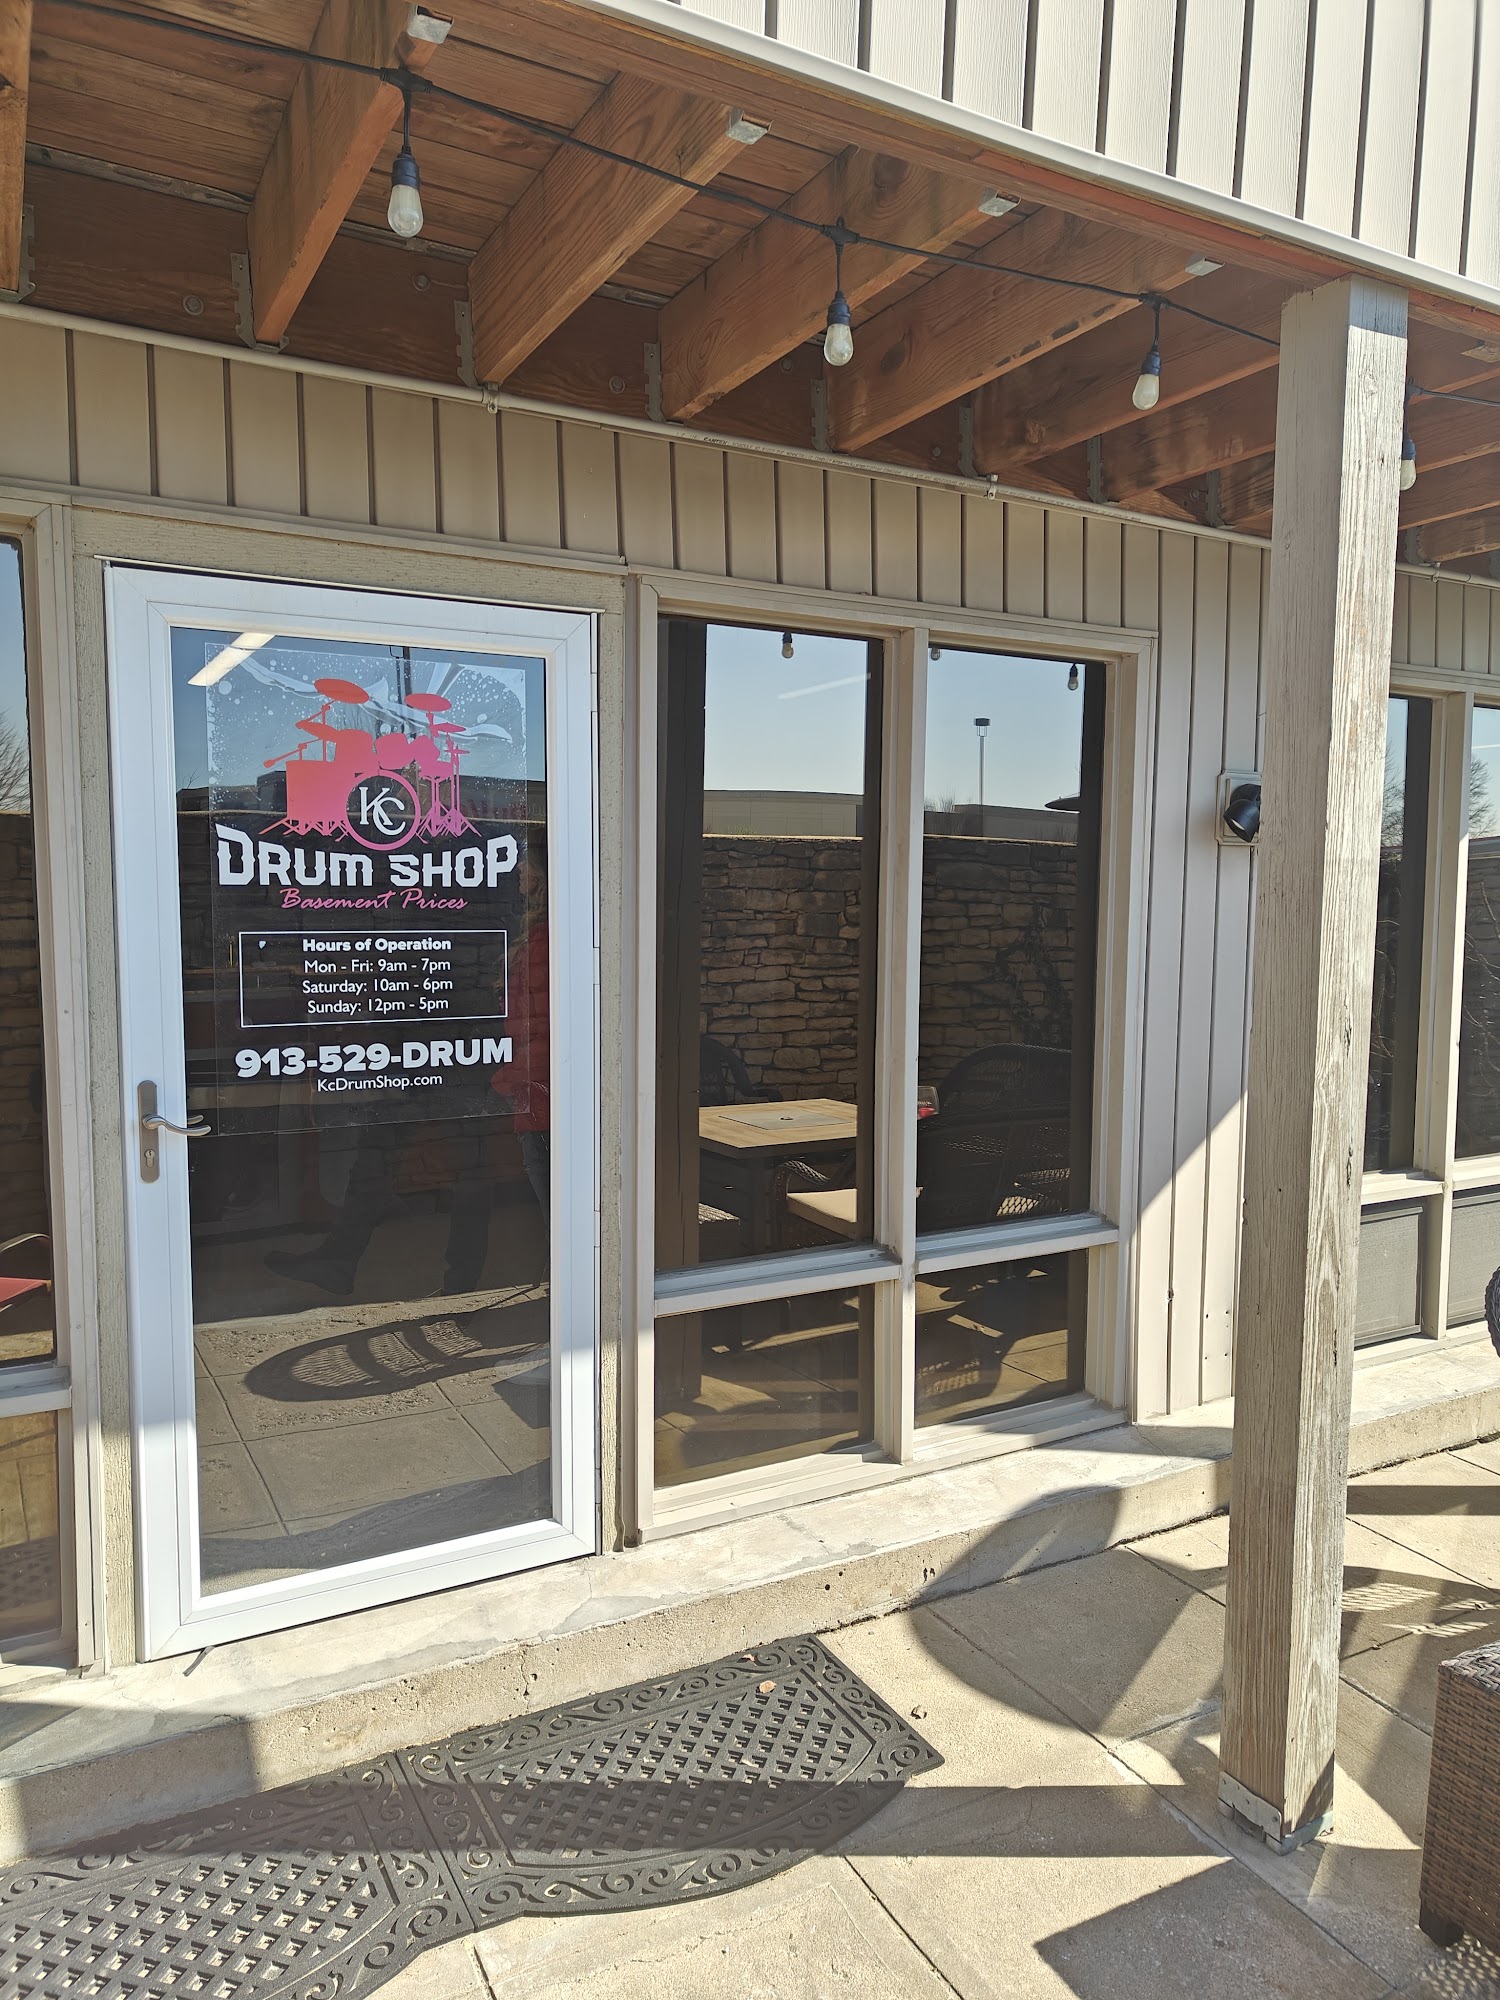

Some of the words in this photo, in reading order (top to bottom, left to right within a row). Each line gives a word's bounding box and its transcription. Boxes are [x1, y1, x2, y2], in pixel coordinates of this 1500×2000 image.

[359, 787, 406, 835] KC
[388, 834, 518, 887] SHOP
[280, 888, 396, 909] Basement
[400, 888, 468, 909] Prices
[303, 939, 351, 951] Hours
[355, 938, 372, 951] of
[375, 937, 451, 953] Operation
[305, 960, 336, 973] Mon
[352, 960, 373, 972] Fri:
[378, 959, 407, 971] 9am
[421, 958, 450, 973] 7pm
[303, 980, 367, 995] Saturday:
[374, 979, 409, 991] 10am
[423, 978, 452, 993] 6pm
[308, 1000, 361, 1015] Sunday:
[367, 998, 405, 1014] 12pm
[419, 997, 448, 1012] 5pm
[235, 1037, 513, 1078] 913-529-DRUM
[318, 1075, 442, 1091] KcDrumShop.com
